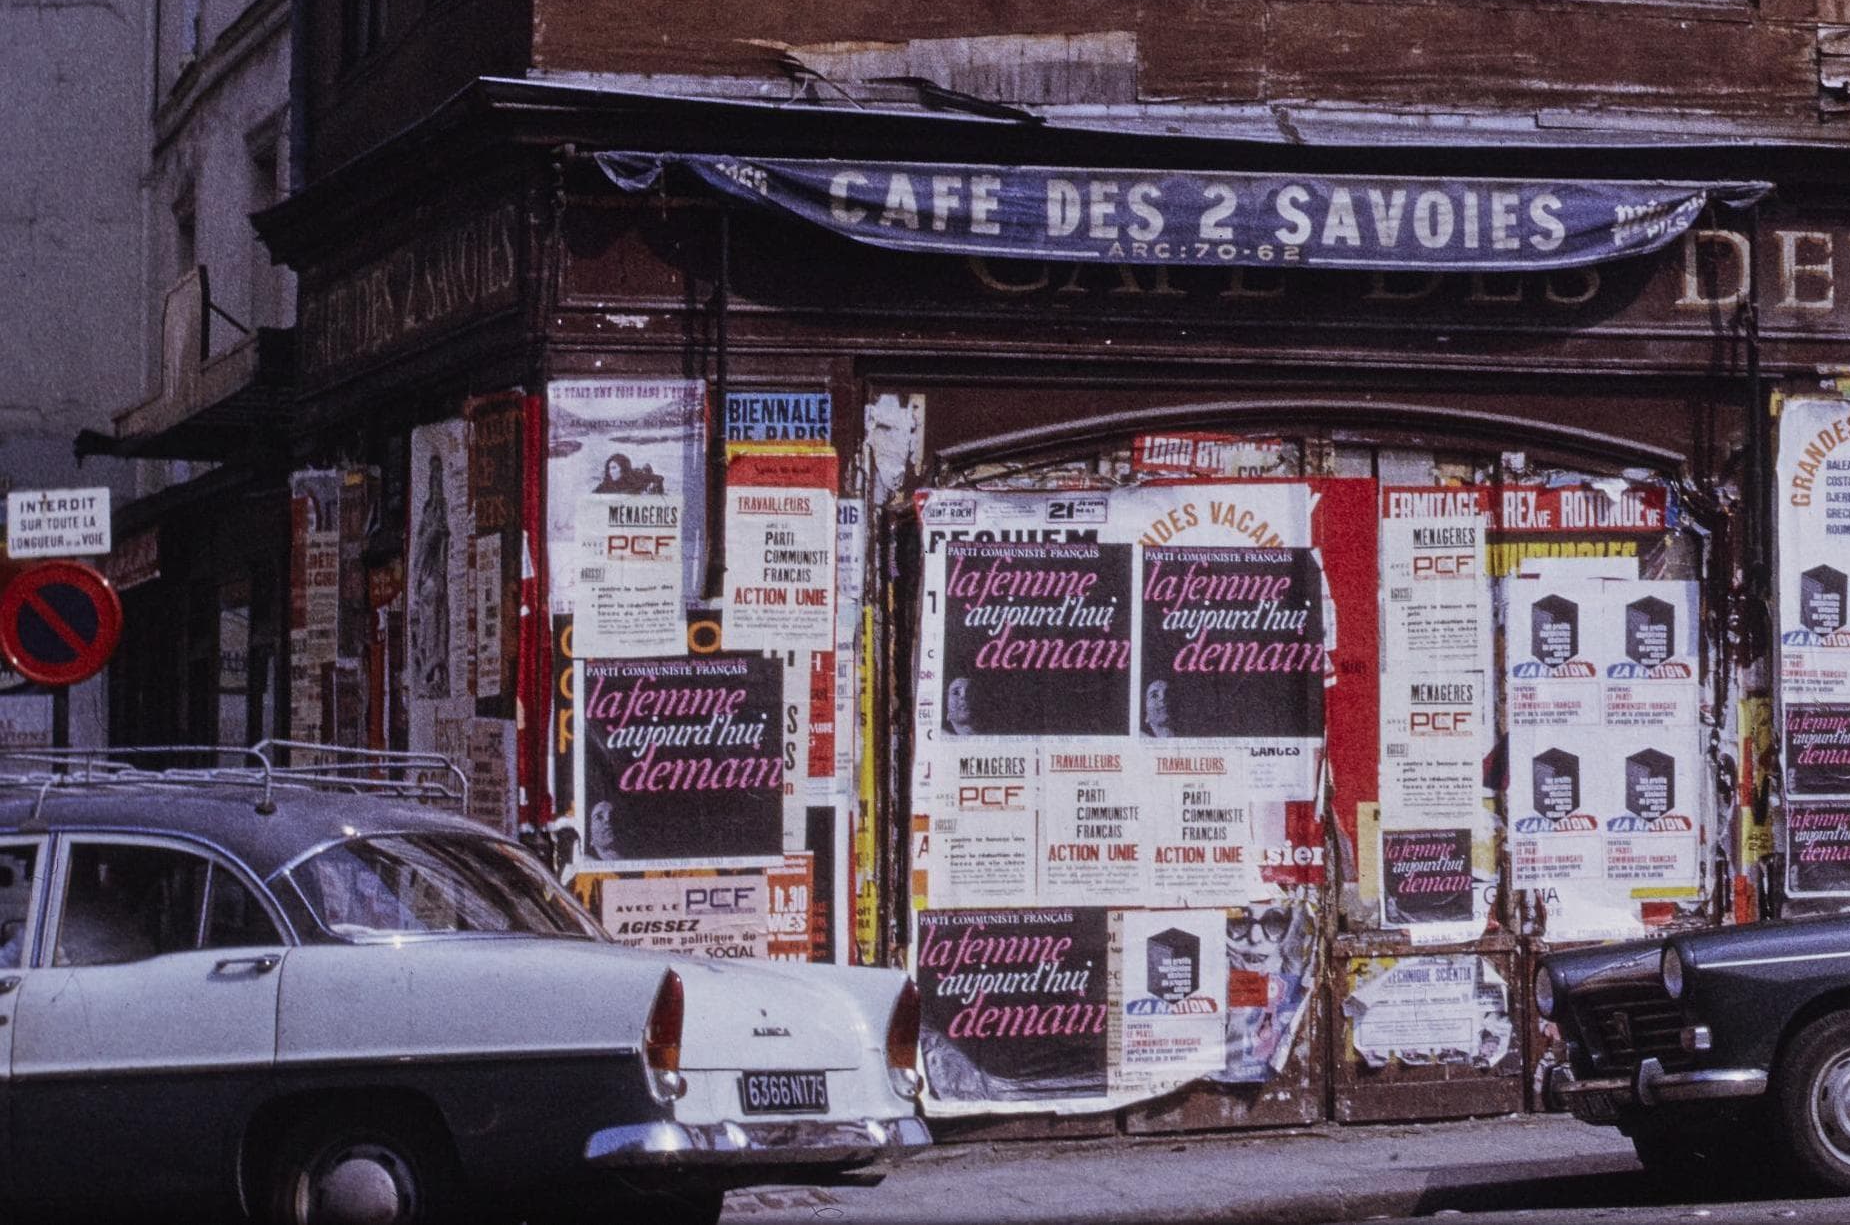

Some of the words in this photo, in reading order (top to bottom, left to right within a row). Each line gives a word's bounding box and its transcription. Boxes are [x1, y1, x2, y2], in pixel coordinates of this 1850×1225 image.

[1046, 179, 1164, 241] DES
[1199, 183, 1238, 240] 2
[1275, 185, 1565, 250] SAVOIES
[728, 398, 830, 425] BIENNALE
[20, 497, 96, 513] INTERDIT
[1048, 502, 1075, 519] 21
[1389, 492, 1480, 519] ERMITAGE
[1503, 491, 1537, 528] REX
[21, 518, 42, 532] SUR
[47, 516, 79, 530] TOUTE
[83, 515, 96, 528] LA
[11, 535, 64, 551] LONGUEUR
[82, 531, 104, 545] VOIE
[608, 535, 676, 555] PCF
[765, 532, 794, 546] PARTI
[764, 550, 828, 565] COMMUNISTE
[947, 547, 977, 558] PARTI
[981, 547, 1047, 558] COMMUNISTE
[1050, 547, 1099, 559] FRANÇAIS
[1145, 551, 1174, 562] PARTI
[1178, 551, 1241, 563] COMMUNISTE
[1244, 552, 1292, 564] FRANÇAIS
[1413, 556, 1475, 575] PCF
[966, 556, 1097, 611] femme
[1164, 560, 1290, 613] femme
[734, 588, 787, 606] ACTION
[795, 588, 828, 606] UNIE
[965, 597, 1117, 636] aujourd'hui
[1163, 600, 1310, 639] aujourd'hui
[975, 624, 1130, 670] demain
[1174, 627, 1324, 673] demain
[586, 667, 618, 677] PARTI
[623, 666, 692, 676] COMMUNISTE
[697, 664, 748, 675] FRANÇAIS
[607, 676, 746, 731] femme
[1411, 712, 1472, 731] PCF
[607, 713, 768, 758] aujourd'hui
[619, 741, 784, 791] demain
[959, 786, 1025, 807] PCF
[1077, 789, 1105, 803] PARTI
[1183, 791, 1211, 805] PARTI
[1077, 807, 1139, 821] COMMUNISTE
[1182, 809, 1244, 823] COMMUNISTE
[1048, 844, 1099, 862] ACTION
[1108, 844, 1139, 861] UNIE
[1155, 846, 1206, 863] ACTION
[1213, 846, 1244, 863] UNIE
[686, 887, 756, 908] PCF
[618, 919, 699, 935] AGISSEZ
[920, 916, 948, 926] PARTI
[952, 914, 1020, 925] COMMUNISTE
[1024, 913, 1074, 925] FRANÇAIS
[681, 933, 734, 946] politique
[938, 924, 1071, 979] femme
[937, 961, 1093, 1004] aujourd'hui
[949, 989, 1106, 1038] demain
